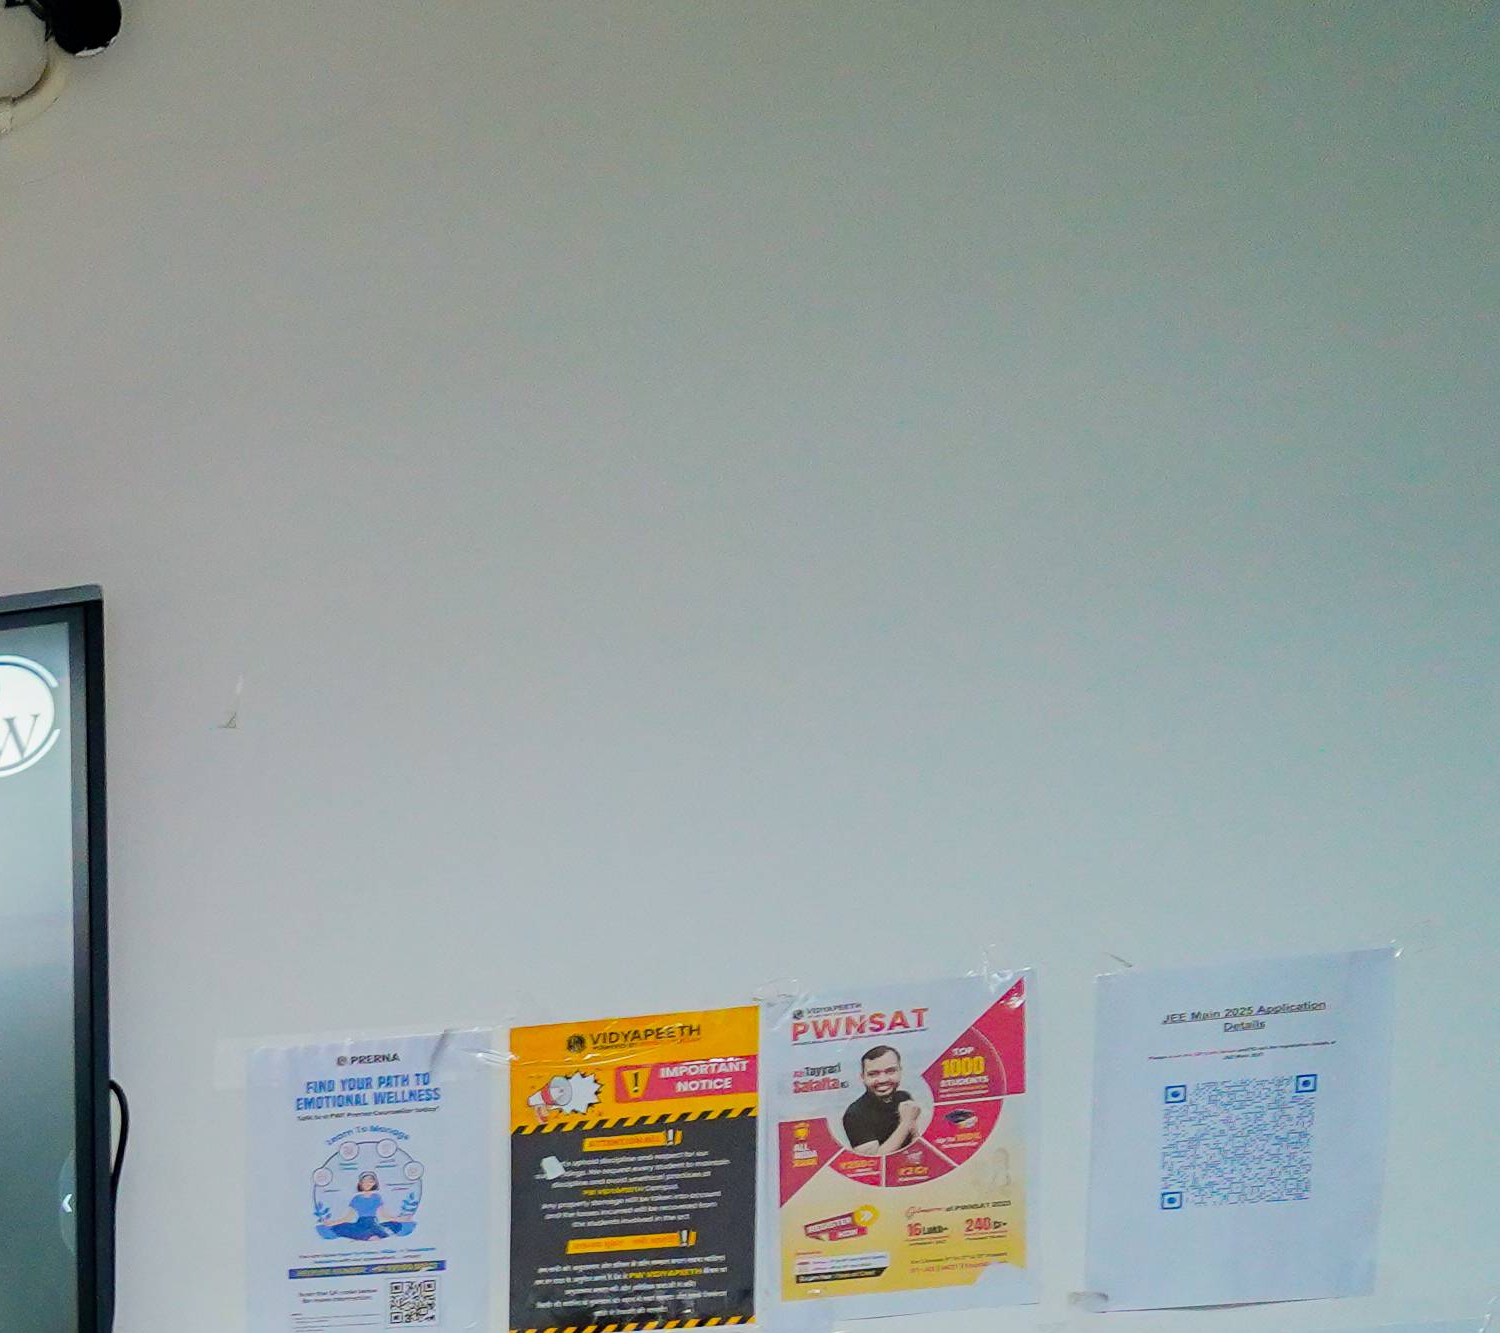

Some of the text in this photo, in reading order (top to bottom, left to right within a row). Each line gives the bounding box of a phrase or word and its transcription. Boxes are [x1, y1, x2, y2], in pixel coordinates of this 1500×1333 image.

[590, 1024, 700, 1044] VIDYAPEETH
[792, 1008, 929, 1041] PWNSAT
[350, 1053, 400, 1064] PRERNA
[660, 1060, 749, 1078] IMPORTANT
[306, 1072, 430, 1093] FIND YOUR PATH TO
[675, 1077, 733, 1093] NOTICE
[296, 1088, 441, 1111] EMOTIONAL WELLNESS
